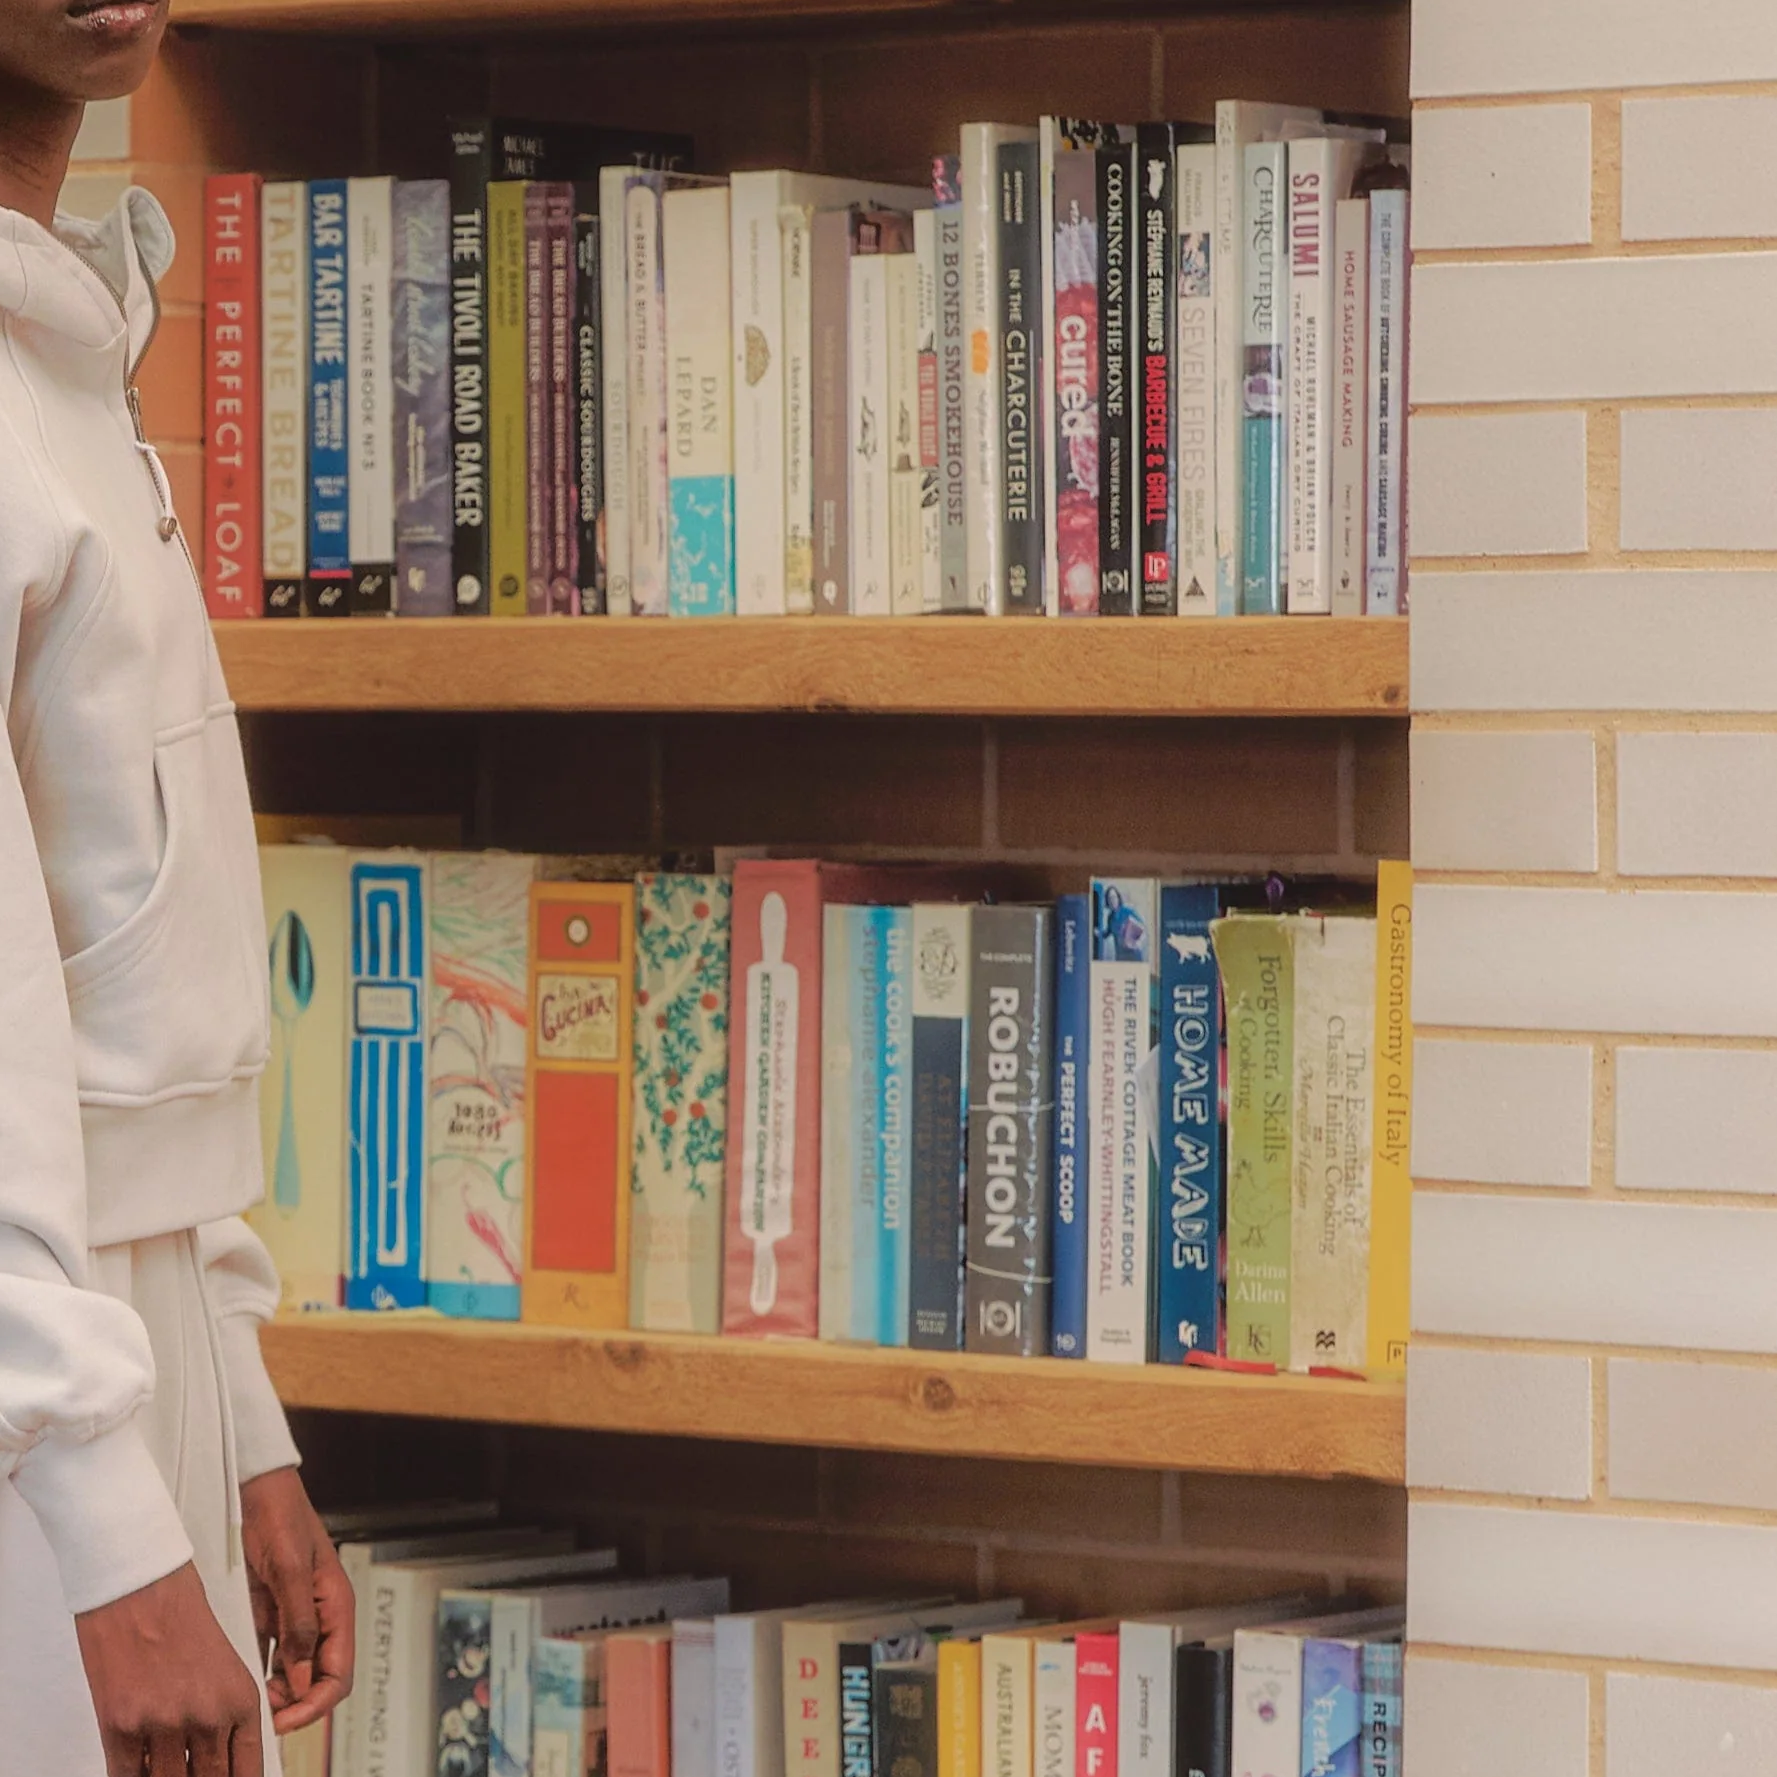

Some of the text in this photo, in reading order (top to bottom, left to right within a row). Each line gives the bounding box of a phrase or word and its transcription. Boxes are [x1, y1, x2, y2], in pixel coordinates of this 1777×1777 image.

[528, 239, 543, 267] THE
[552, 237, 568, 267] THE
[1252, 166, 1274, 334] CHARCUTERIE
[1292, 172, 1320, 278] SALUMI
[313, 193, 345, 366] BAR TARTINE
[528, 269, 543, 316] BREAD
[552, 269, 568, 316] BREAD
[1106, 164, 1124, 418] COOKING ON THE BONE
[1146, 277, 1165, 352] REYNAUD'S
[1293, 291, 1302, 320] THE
[267, 188, 297, 577] TARTINE BREAD
[453, 208, 481, 527] THE TIVOLI ROAD BAKER
[528, 317, 543, 384] BUILDERS
[552, 317, 568, 384] BUILDERS
[942, 221, 963, 527] 12 BONES SMOKEHOUSE
[1059, 315, 1093, 440] cured
[1293, 325, 1302, 373] CRAFT
[1305, 316, 1316, 372] MICHAEL
[1342, 250, 1356, 448] HOME SAUSAGE MAKING
[216, 192, 242, 604] THE PERFECT LOAF
[579, 325, 596, 523] CLASSIC SOURDOUGHS
[676, 355, 694, 459] LEPARD
[701, 375, 718, 434] DAN
[1007, 269, 1026, 522] IN THE CHARCUTERIE
[1146, 355, 1165, 449] BARBECUE
[1182, 307, 1206, 481] SEVEN FIRES
[1293, 402, 1302, 458] ITALIAN
[1305, 377, 1316, 439] RUHLMAN
[609, 378, 625, 512] SOURDOUGH
[1146, 453, 1165, 468] &
[1293, 464, 1302, 491] DRY
[1305, 459, 1316, 497] BRIAN
[1146, 471, 1165, 526] GRILL
[1293, 496, 1302, 553] CURING
[1305, 502, 1316, 553] POLCYN
[1063, 919, 1076, 973] Lebovitz
[1121, 977, 1137, 1014] THE
[1379, 902, 1411, 1166] Gastronomy of Italy
[773, 998, 789, 1093] Stephanie
[858, 924, 879, 1209] stephanie alexander
[880, 927, 908, 1230] the cook's companion
[753, 971, 771, 1234] KITCHEN GARDEN COMPANION
[985, 986, 1019, 1248] ROBUCHON
[1059, 1061, 1075, 1148] PERFECT
[1100, 978, 1115, 1296] HUGH FEARNLEY-WHITTINGSTALL
[1121, 1080, 1137, 1169] COTTAGE
[1172, 984, 1209, 1270] HOME MADE
[1319, 1014, 1345, 1256] Classic Italian Cooking
[1344, 1048, 1366, 1229] The Essentials of
[1059, 1153, 1075, 1225] SCOOP
[1121, 1173, 1137, 1229] MEAT
[1121, 1232, 1137, 1288] BOOK
[1234, 1280, 1286, 1303] Allen
[368, 1586, 396, 1744] EVERYTHING
[1136, 1674, 1153, 1759] jeremy fox
[1311, 1696, 1334, 1777] French
